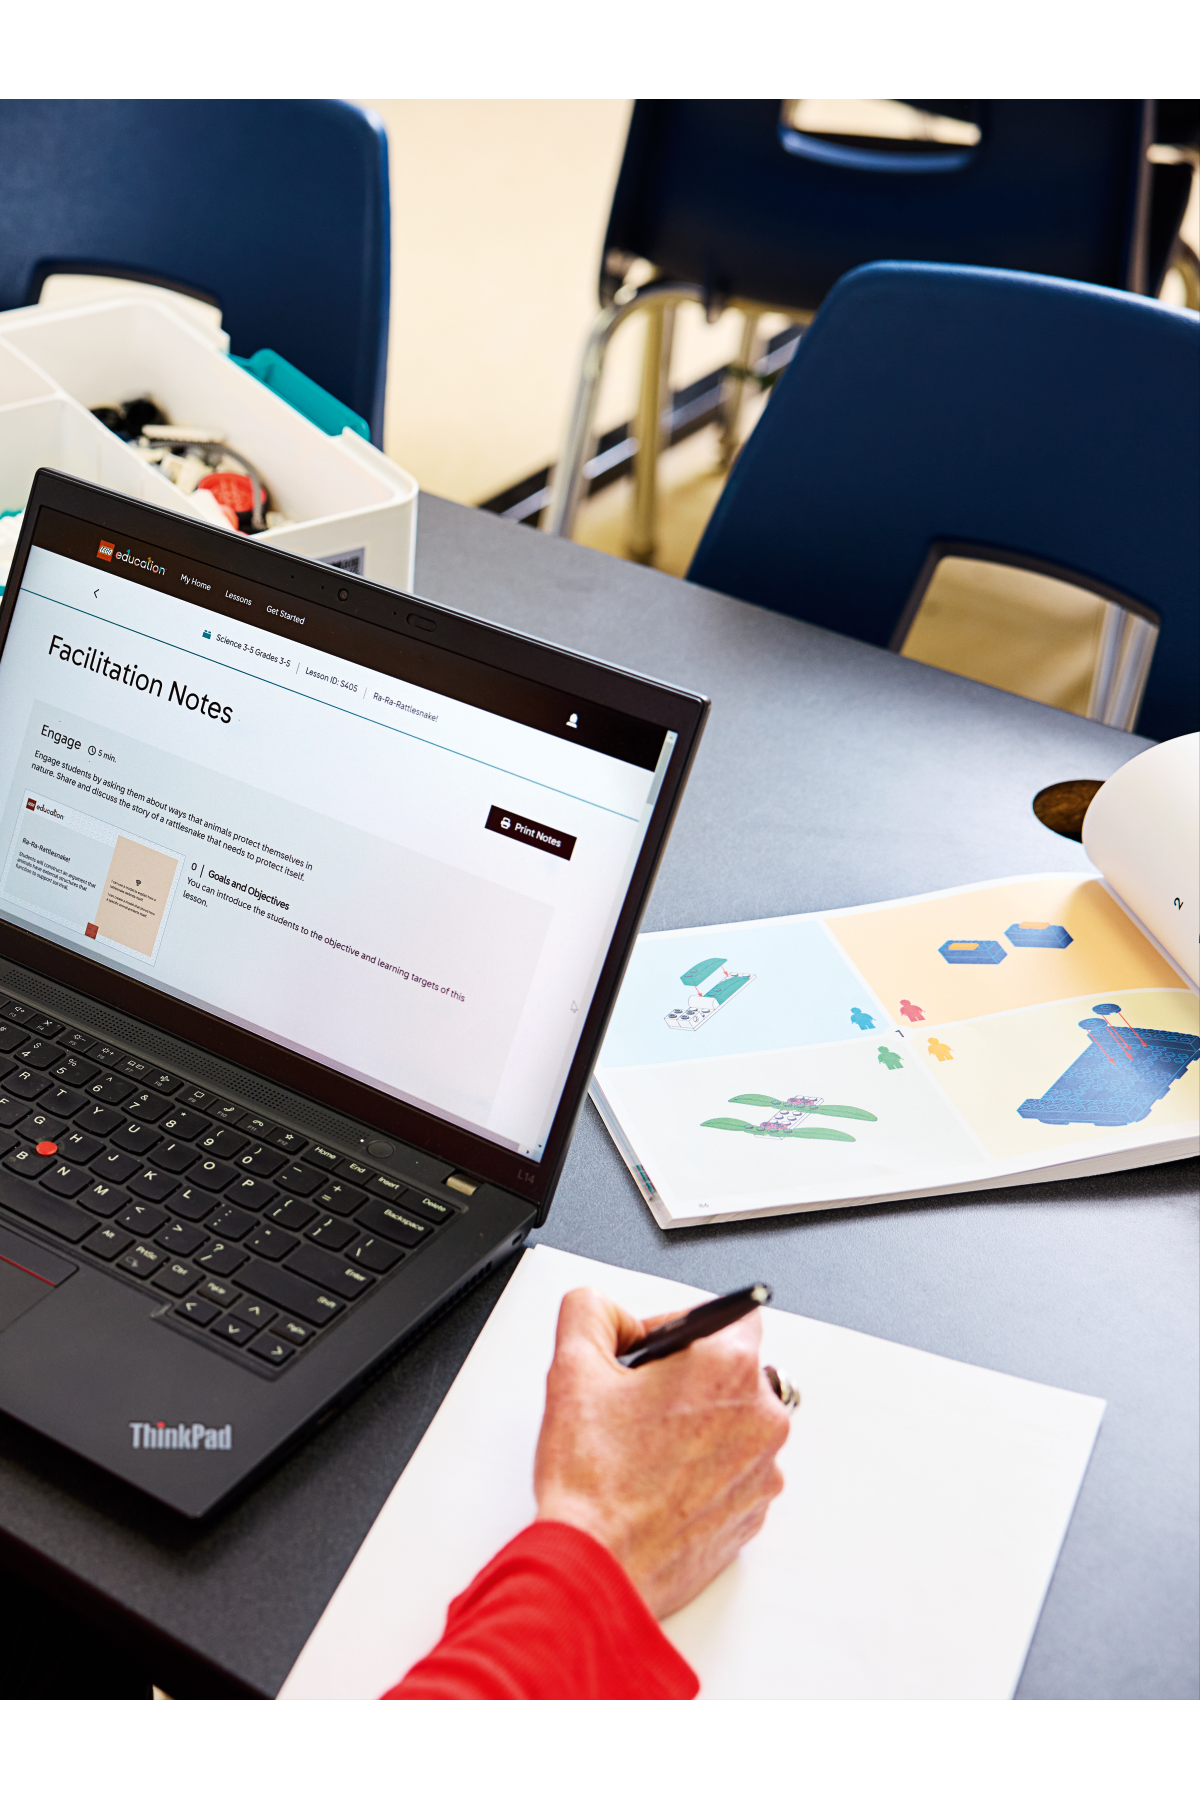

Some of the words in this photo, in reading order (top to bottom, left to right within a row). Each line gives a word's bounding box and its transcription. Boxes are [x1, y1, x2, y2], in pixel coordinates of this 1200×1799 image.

[99, 546, 113, 557] LEGO
[115, 549, 166, 576] education
[180, 573, 191, 585] My
[190, 577, 212, 591] Home
[224, 589, 252, 606] Lessons
[266, 604, 279, 616] Get
[279, 609, 306, 625] Started
[215, 633, 242, 650] Science
[242, 643, 255, 654] 3-5
[254, 648, 279, 663] Grades
[278, 656, 291, 668] 3-5
[48, 634, 163, 698] Facilitation
[167, 680, 233, 724] Notes
[305, 666, 329, 682] Lesson
[329, 675, 340, 686] ID:
[339, 679, 358, 693] S405
[372, 691, 439, 722] Ra-Ra-Rattlesnake!
[40, 723, 82, 750] Engage
[97, 749, 103, 757] 5
[102, 752, 117, 763] min.
[34, 749, 61, 767] Engage
[61, 762, 92, 780] students
[92, 773, 103, 785] by
[102, 779, 126, 795] asking
[126, 788, 146, 802] them
[145, 796, 168, 811] about
[168, 805, 187, 819] ways
[187, 813, 203, 826] that
[203, 820, 232, 838] animals
[232, 833, 261, 850] protect
[261, 843, 305, 868] themselves
[305, 860, 313, 871] in
[36, 803, 64, 821] education
[30, 762, 55, 778] nature.
[55, 771, 77, 786] Share
[76, 781, 92, 792] and
[91, 787, 118, 804] discuss
[118, 798, 131, 809] the
[131, 804, 151, 819] story
[150, 812, 160, 821] of
[165, 818, 206, 840] rattlesnake
[206, 834, 222, 847] that
[222, 842, 246, 857] needs
[246, 851, 255, 861] to
[254, 856, 284, 873] protect
[284, 866, 305, 882] itself.
[514, 822, 536, 838] Print
[535, 830, 562, 848] Notes
[190, 862, 198, 871] 0
[208, 869, 231, 886] Goals
[230, 880, 248, 893] and
[247, 886, 290, 911] Objectives
[182, 889, 208, 908] lesson.
[1173, 897, 1184, 911] 2
[187, 876, 201, 889] You
[201, 884, 216, 896] can
[215, 888, 252, 911] introduce
[252, 905, 266, 917] the
[266, 912, 300, 931] students
[300, 926, 309, 935] to
[309, 930, 324, 942] the
[323, 937, 360, 957] objective
[360, 952, 377, 964] and
[376, 957, 410, 980] learning
[411, 973, 439, 991] targets
[440, 987, 451, 995] of
[450, 990, 465, 1002] this
[21, 1050, 32, 1058] 4
[18, 1070, 32, 1081] R
[55, 1066, 68, 1075] 5
[56, 1088, 68, 1097] T
[92, 1084, 104, 1093] 6
[92, 1105, 105, 1115] Y
[128, 1101, 141, 1110] 7
[33, 1115, 47, 1126] G
[165, 1119, 178, 1129] 8
[127, 1123, 142, 1134] U
[68, 1133, 84, 1144] H
[203, 1137, 215, 1147] 9
[15, 1150, 30, 1161] B
[107, 1154, 120, 1162] J
[314, 1146, 337, 1160] Home
[202, 1160, 217, 1171] O
[241, 1155, 254, 1165] 0
[56, 1165, 72, 1177] N
[348, 1162, 367, 1174] End
[143, 1170, 158, 1181] K
[517, 1169, 536, 1185] L14
[241, 1178, 255, 1187] P
[377, 1176, 401, 1190] Insert
[93, 1184, 110, 1196] M
[182, 1189, 192, 1200] L
[421, 1197, 447, 1213] Delete
[383, 1208, 425, 1232] Backspace
[102, 1229, 116, 1239] Alt
[171, 1264, 188, 1275] Ctrl
[344, 1268, 366, 1282] Enter
[316, 1296, 337, 1309] Shift
[128, 1421, 233, 1451] ThinkPad
